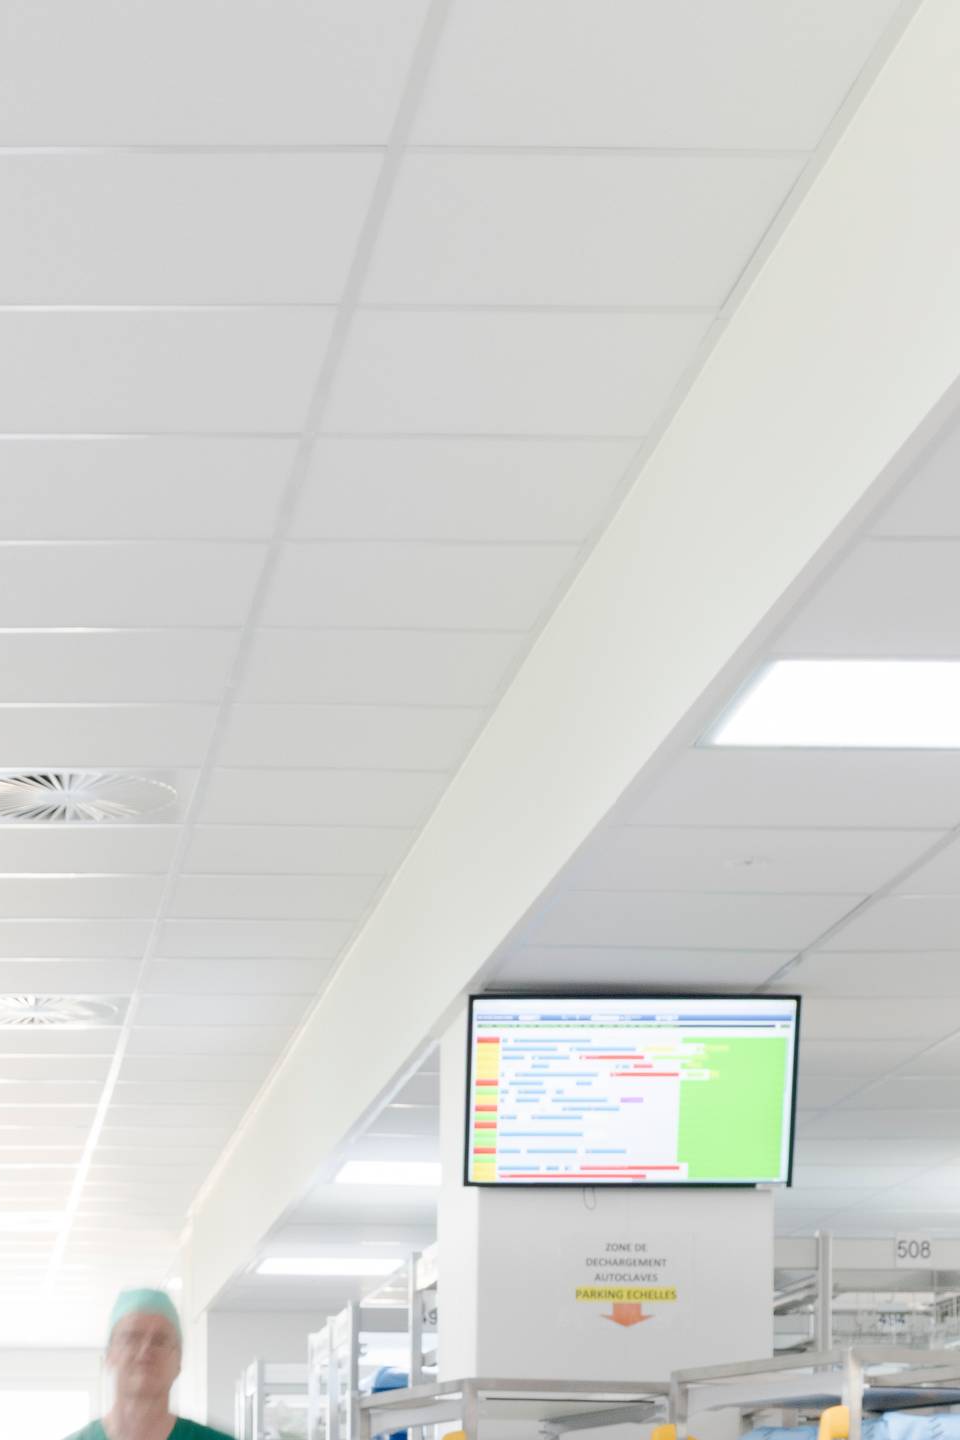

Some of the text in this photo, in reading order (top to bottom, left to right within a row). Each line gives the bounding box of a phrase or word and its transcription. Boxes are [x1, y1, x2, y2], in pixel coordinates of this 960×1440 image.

[605, 1242, 647, 1253] ZONE DE
[896, 1240, 931, 1259] 508
[585, 1257, 667, 1268] DECHARGEMENT
[594, 1273, 658, 1282] AUTOCLAVES
[575, 1288, 677, 1300] PARKING ECHELLES
